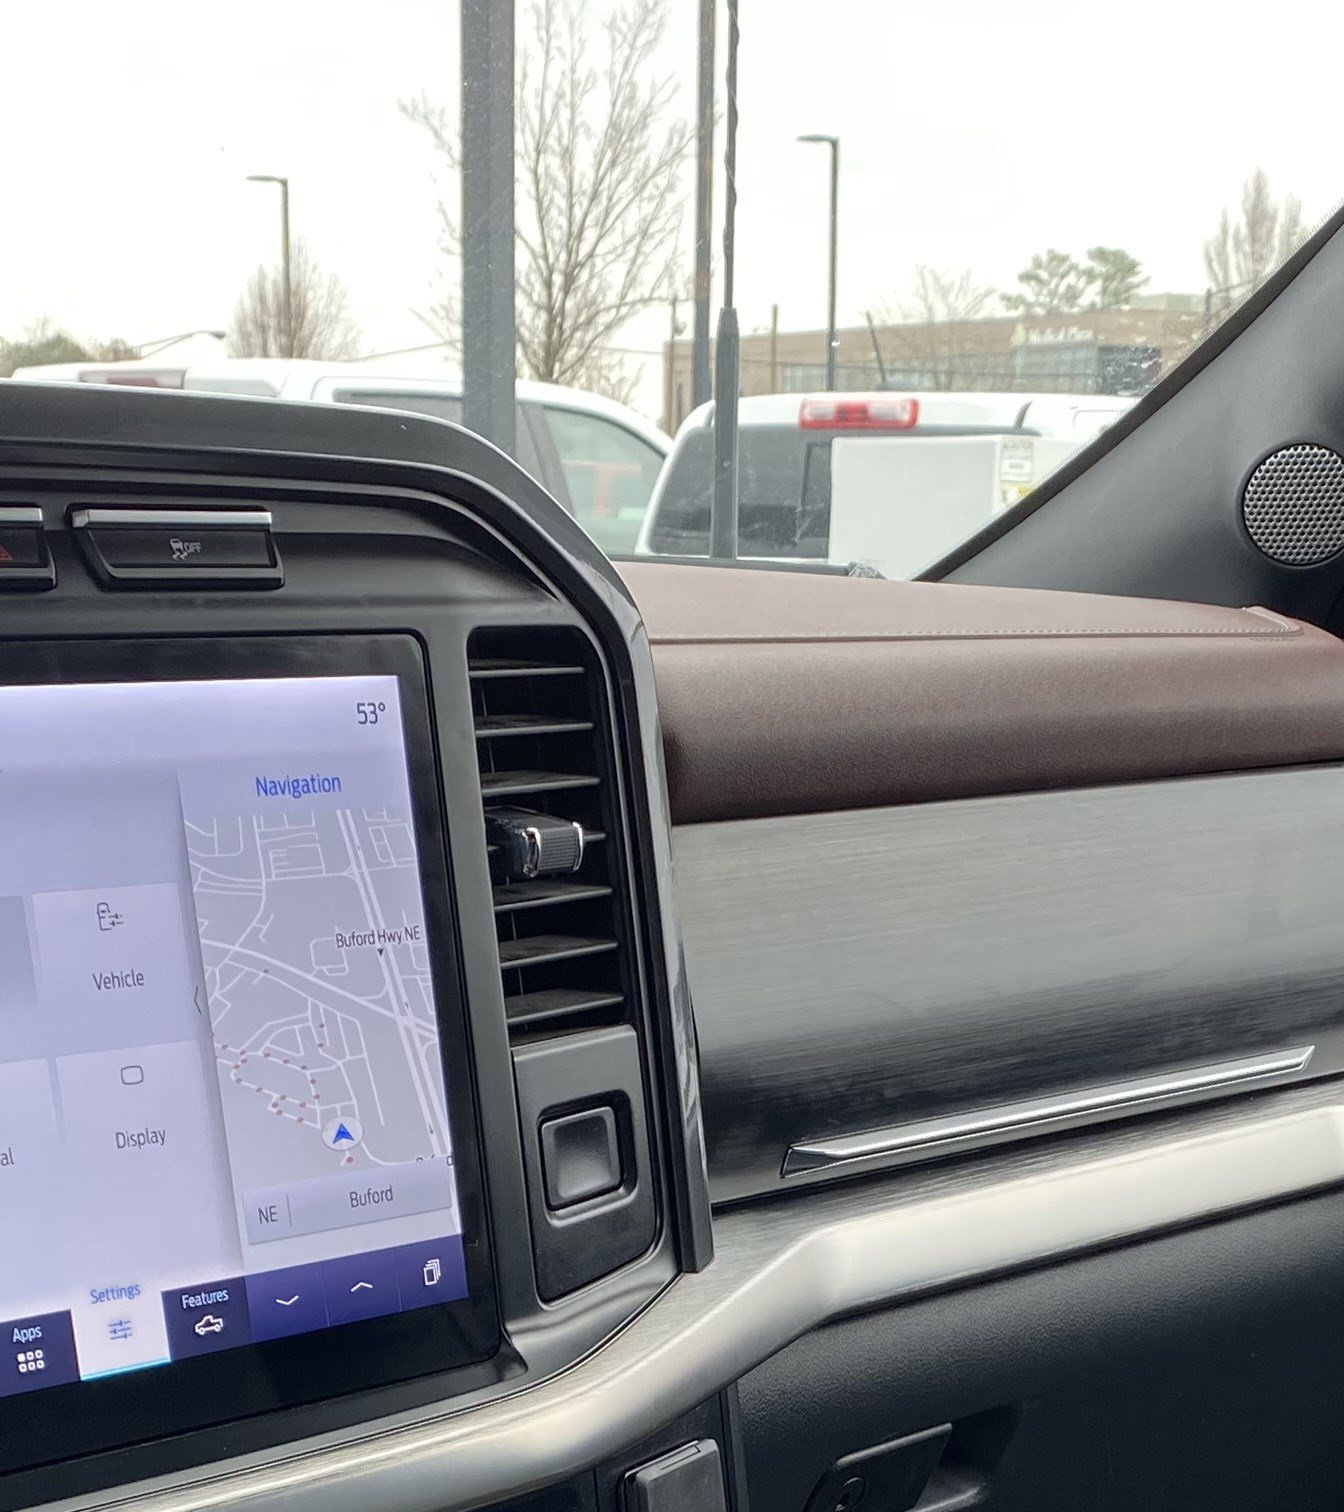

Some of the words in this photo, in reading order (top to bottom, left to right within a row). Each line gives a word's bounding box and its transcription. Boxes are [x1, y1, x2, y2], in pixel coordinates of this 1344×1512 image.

[184, 542, 202, 553] OFF
[255, 774, 341, 799] Navigation
[336, 930, 376, 948] Buford
[377, 929, 402, 945] Hwy
[404, 925, 421, 941] NE
[93, 968, 145, 991] Vehicle
[115, 1127, 167, 1151] Display
[349, 1185, 394, 1209] Buford
[257, 1205, 278, 1225] NE
[90, 1281, 141, 1305] Settings
[181, 1288, 229, 1310] Features
[12, 1324, 43, 1345] Apps
